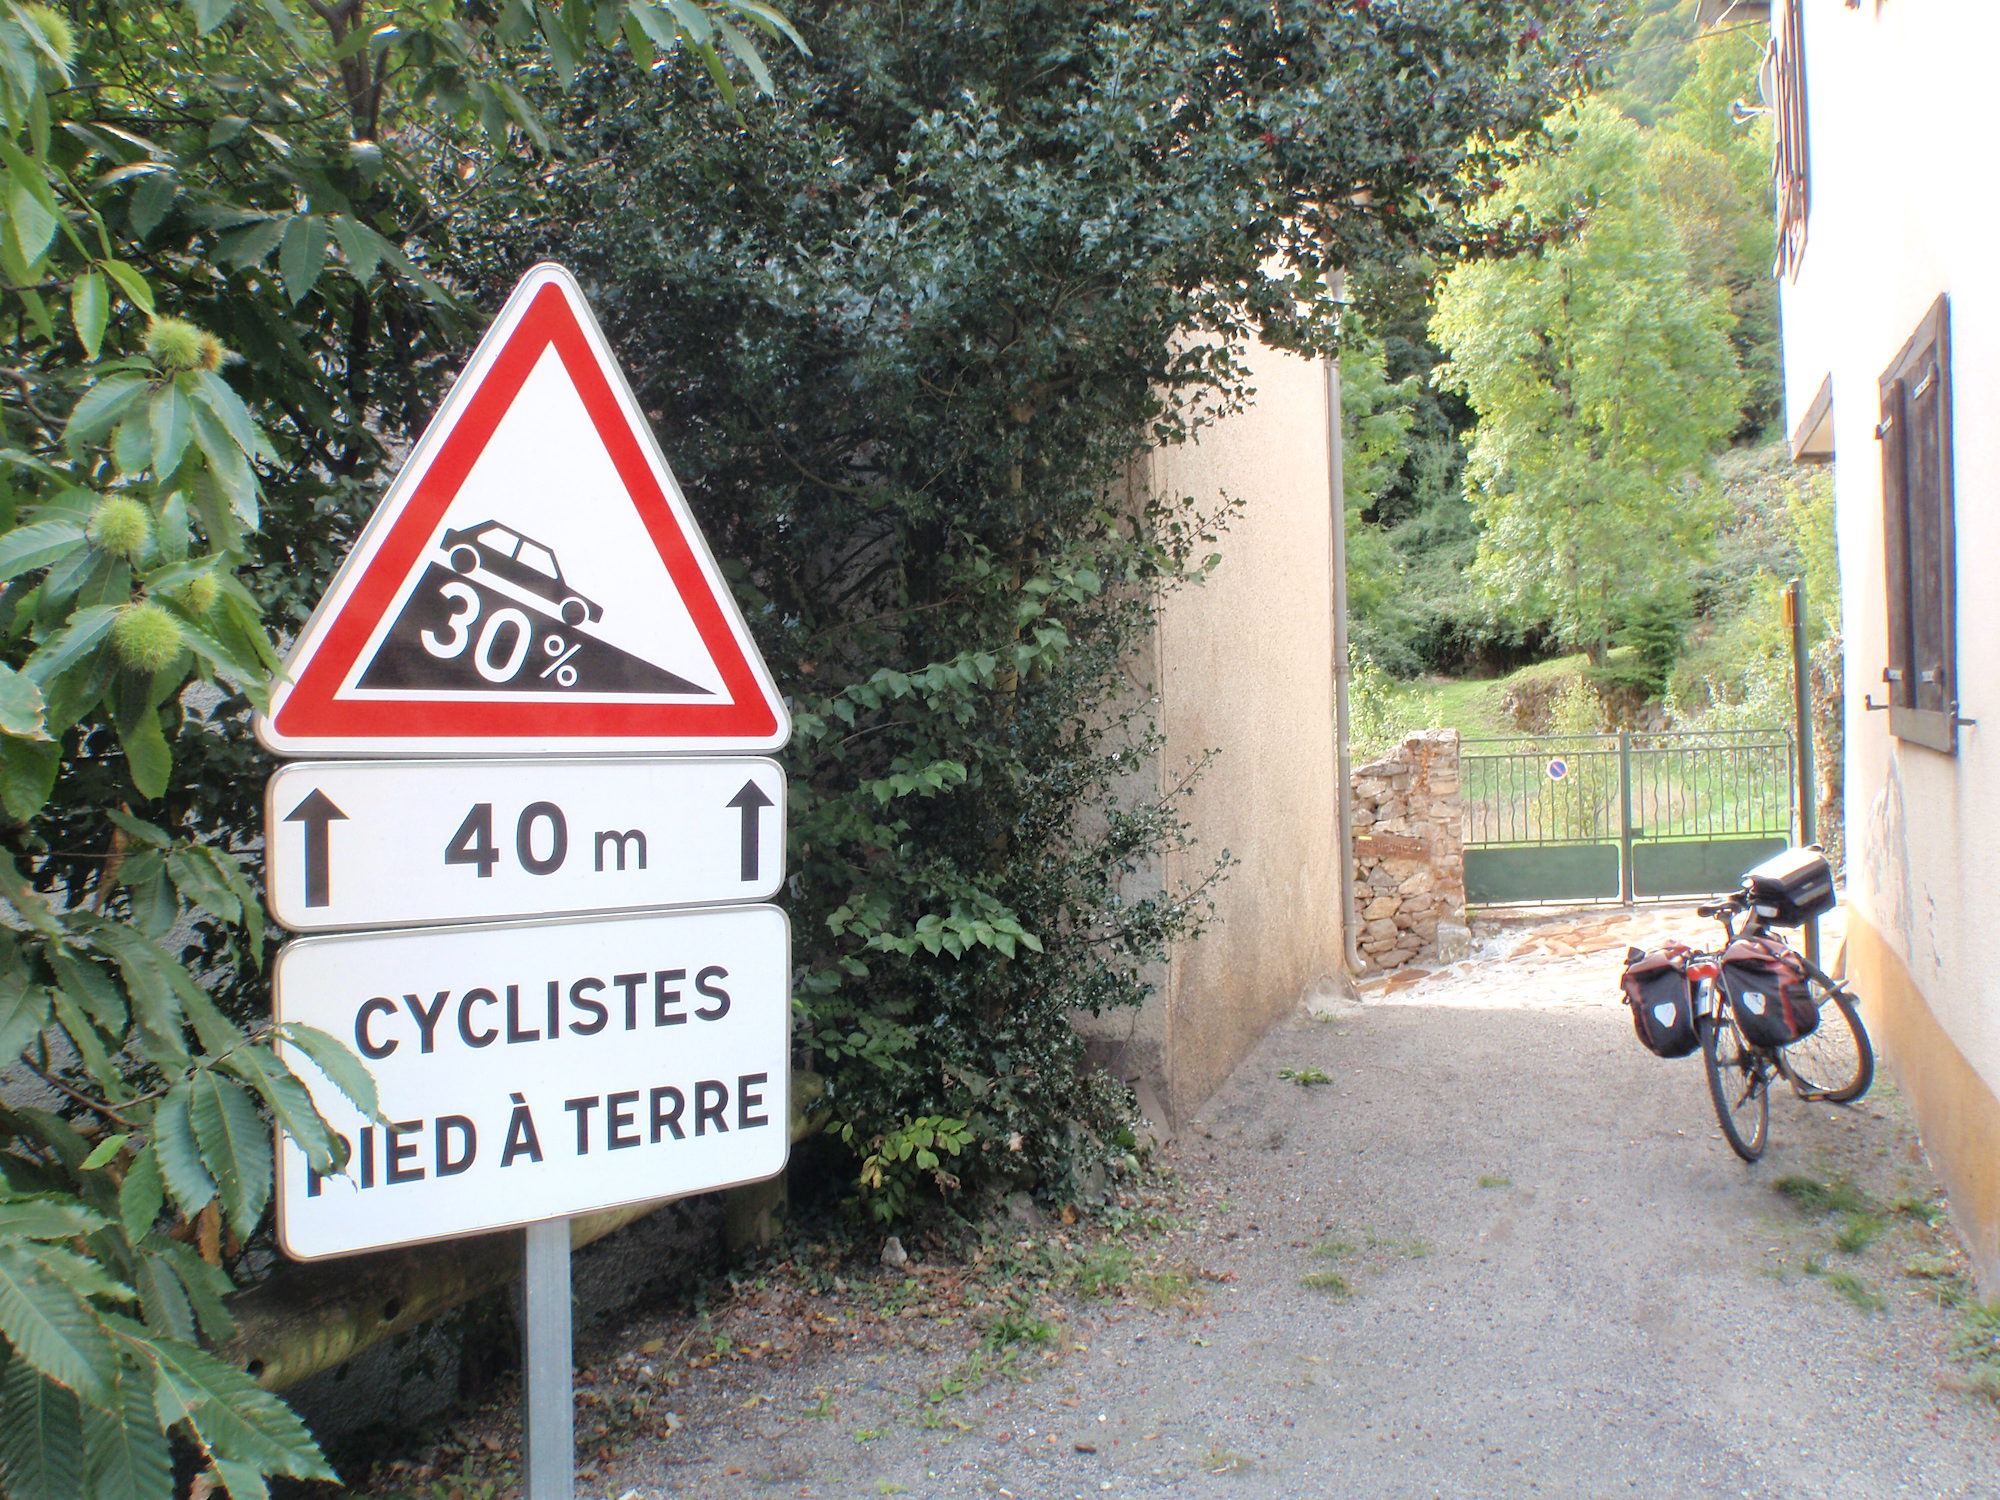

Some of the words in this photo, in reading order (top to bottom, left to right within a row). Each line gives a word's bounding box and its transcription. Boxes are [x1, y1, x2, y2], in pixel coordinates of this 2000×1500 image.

[445, 801, 567, 878] 40
[594, 828, 647, 871] m
[354, 965, 731, 1060] CYCLISTES
[500, 1092, 543, 1168] À
[564, 1072, 769, 1156] TERRE
